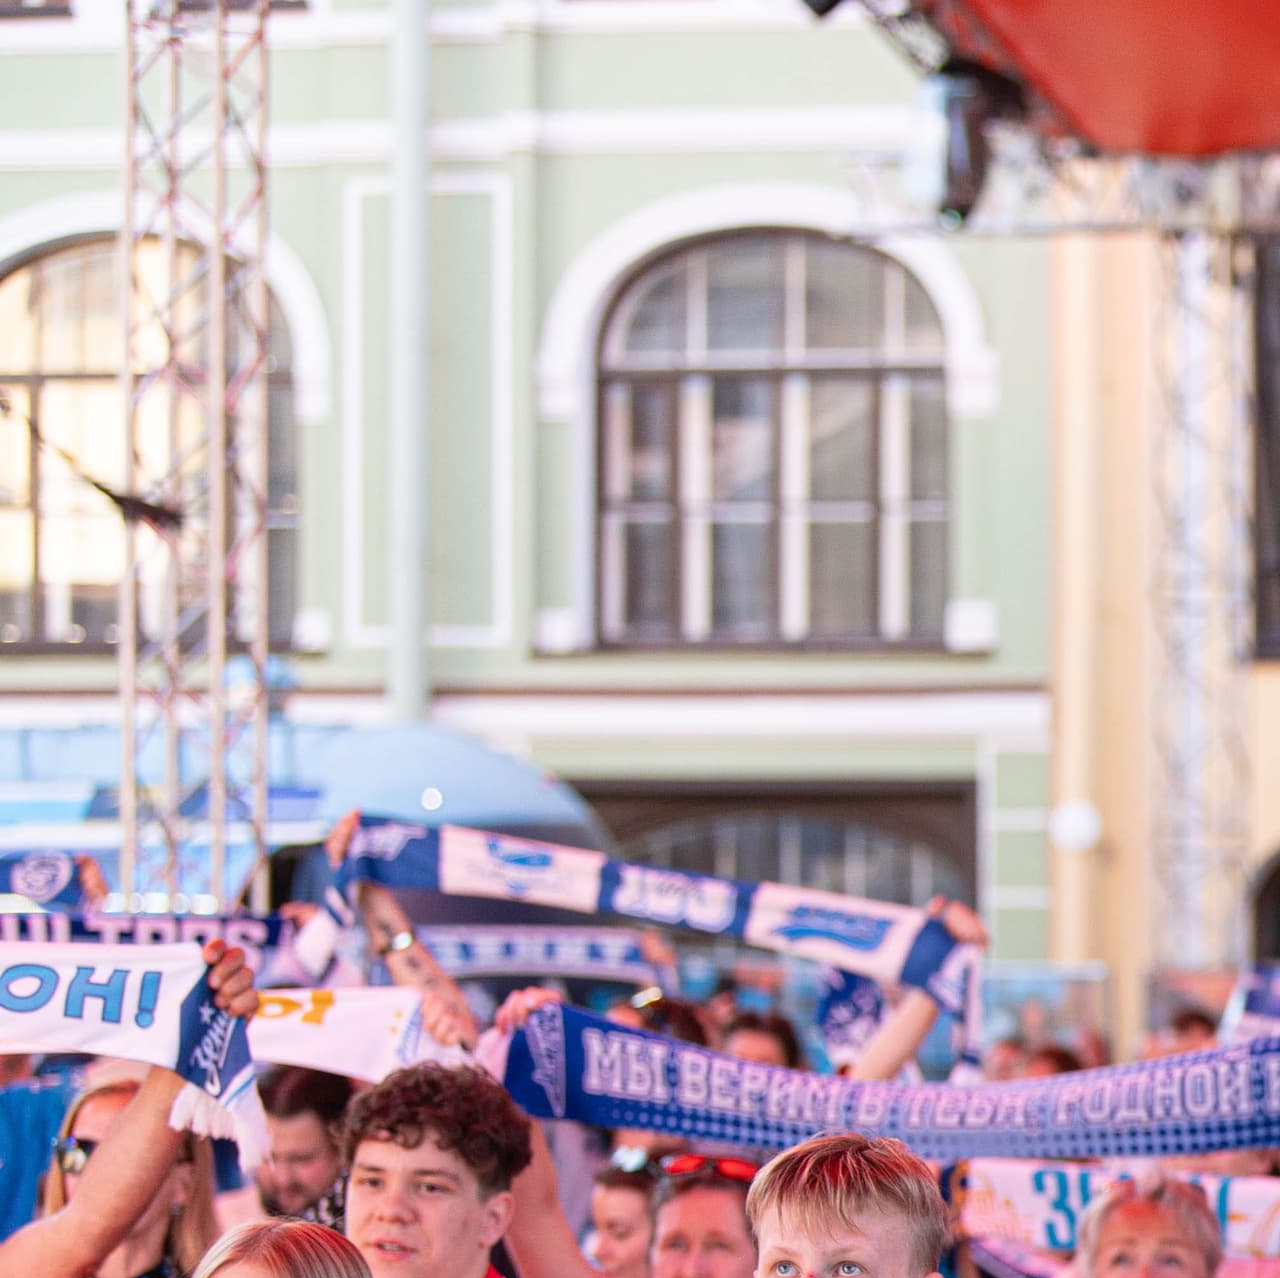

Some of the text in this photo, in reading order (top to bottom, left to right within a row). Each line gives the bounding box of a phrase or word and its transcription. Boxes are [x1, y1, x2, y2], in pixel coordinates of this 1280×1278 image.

[581, 1028, 669, 1104] МЫ
[677, 1045, 846, 1125] ВЕРИМ
[855, 1083, 889, 1128] В
[1053, 1050, 1251, 1128] РОДНОЙ
